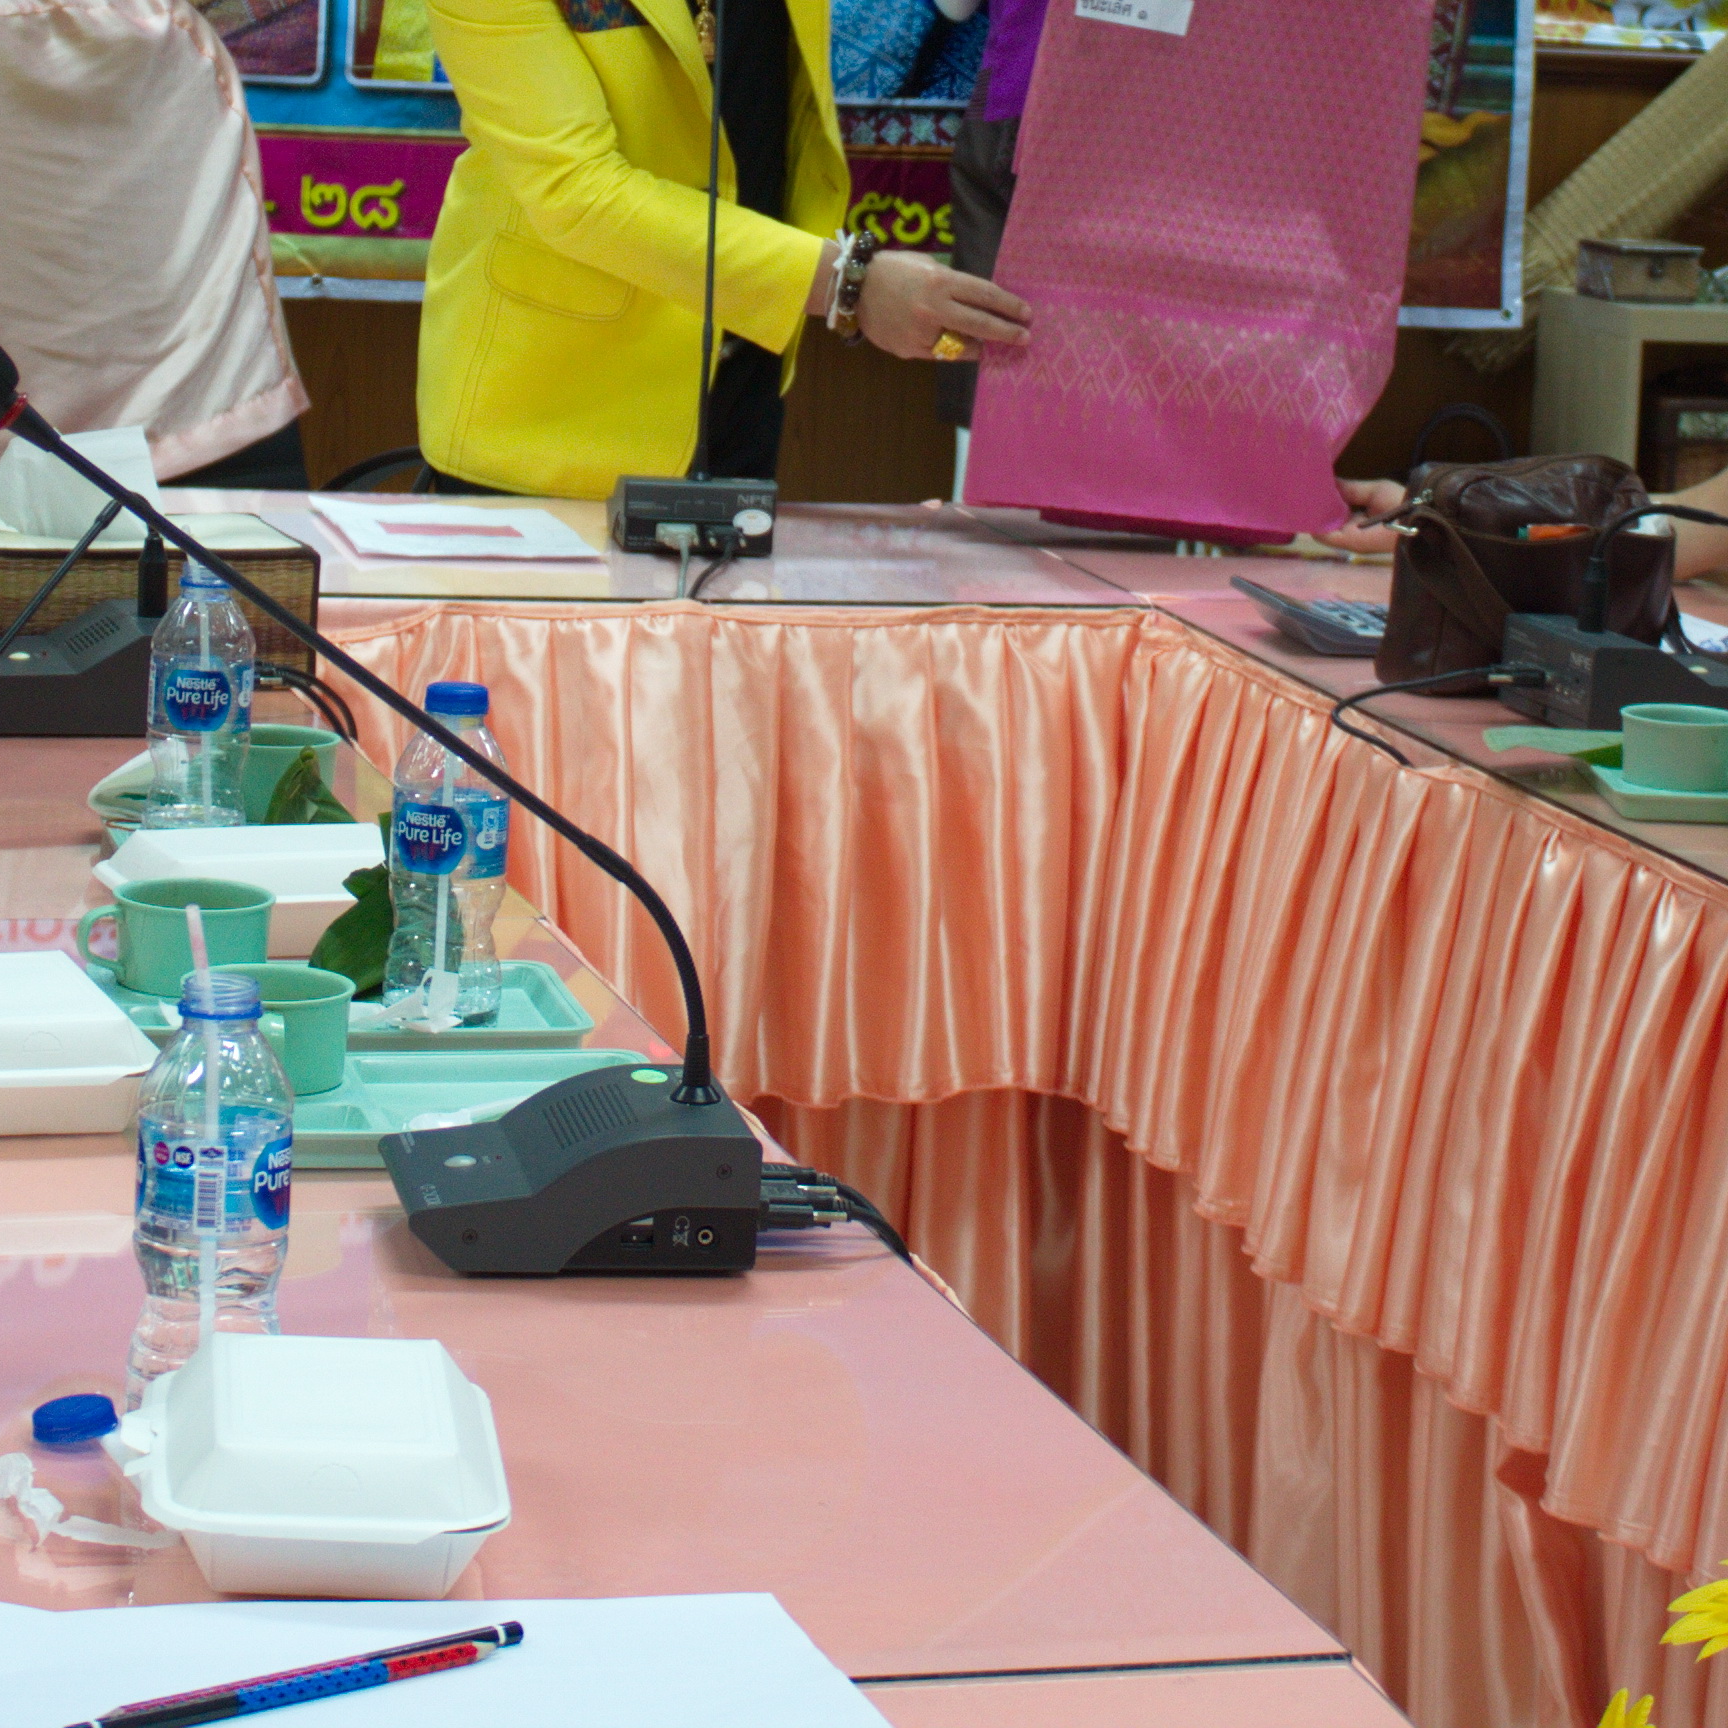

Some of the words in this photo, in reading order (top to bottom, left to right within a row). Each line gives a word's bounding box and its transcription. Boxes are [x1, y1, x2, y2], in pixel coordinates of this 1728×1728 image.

[165, 686, 201, 704] Pure
[203, 690, 229, 711] Life
[398, 821, 430, 843] Pure
[432, 827, 463, 852] Life
